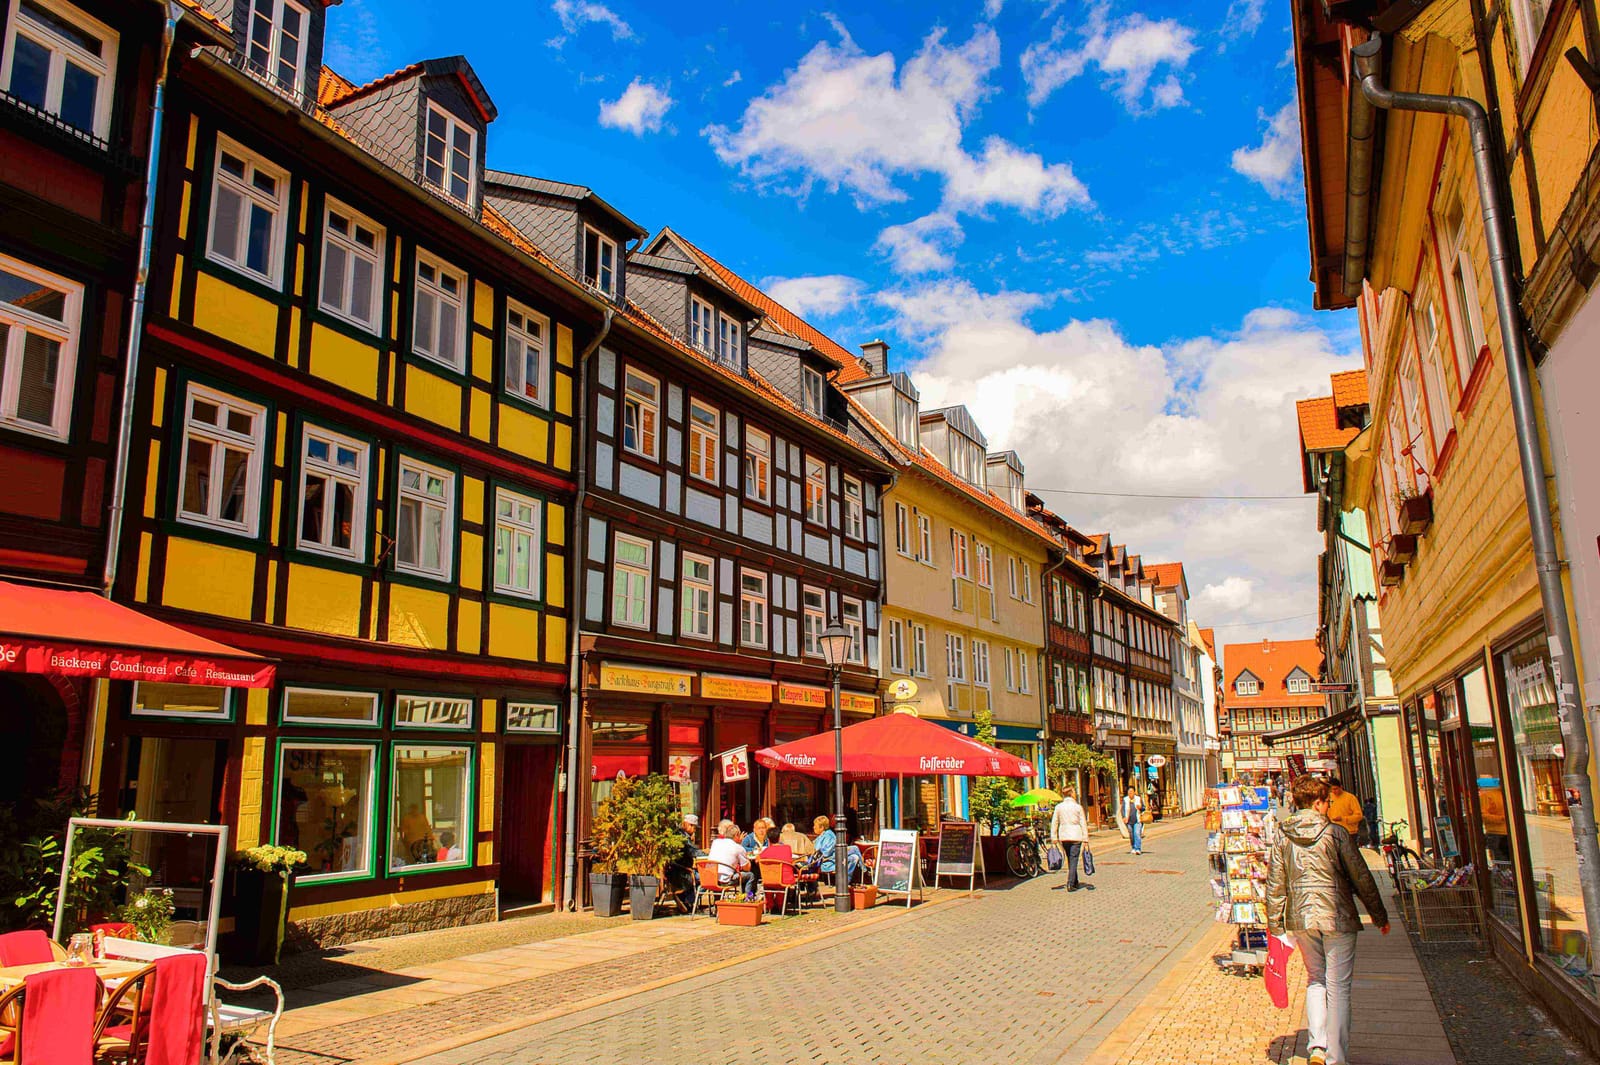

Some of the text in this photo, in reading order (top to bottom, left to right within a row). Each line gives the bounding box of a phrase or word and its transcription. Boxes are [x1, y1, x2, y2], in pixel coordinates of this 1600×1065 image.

[50, 655, 102, 670] Bäckerei
[109, 660, 167, 676] Conditorei
[205, 668, 256, 682] Restaurant
